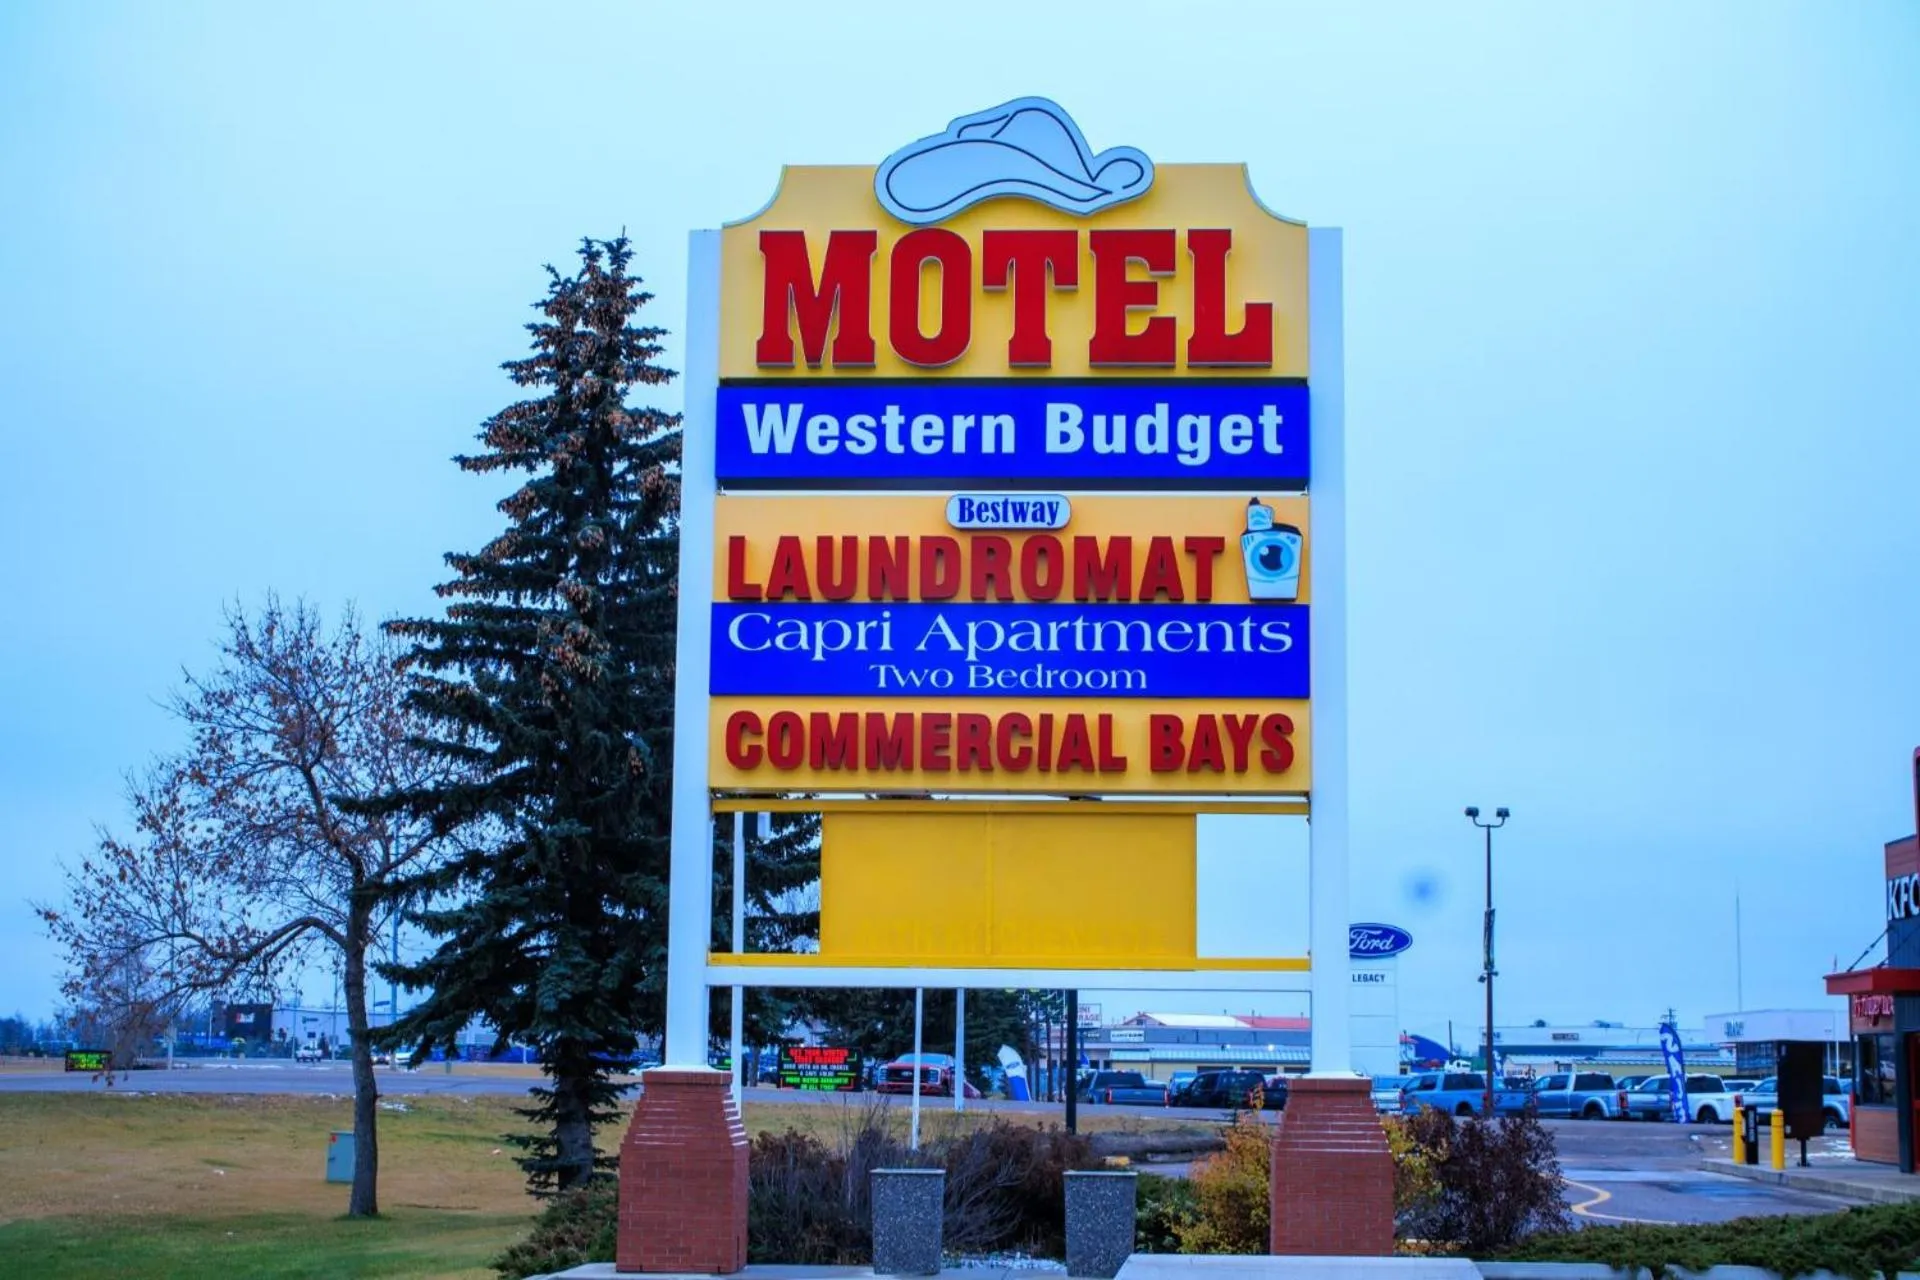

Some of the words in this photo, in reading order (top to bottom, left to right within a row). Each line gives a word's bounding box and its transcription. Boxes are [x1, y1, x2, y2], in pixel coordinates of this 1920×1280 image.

[757, 229, 1273, 370] MOTEL
[742, 403, 1016, 455] Western
[1045, 403, 1284, 466] Budget
[957, 497, 1060, 526] Bestway
[728, 535, 1225, 604] LAUNDROMAT
[728, 611, 892, 661] Capri
[915, 613, 1294, 661] Apartments
[869, 664, 954, 689] Two
[967, 664, 1147, 689] Bedroom
[725, 711, 1127, 774] COMMERCIAL
[1150, 713, 1294, 775] BAYS
[1887, 873, 1920, 922] KFC
[1349, 928, 1395, 951] Ford
[1352, 973, 1386, 983] LEGACY
